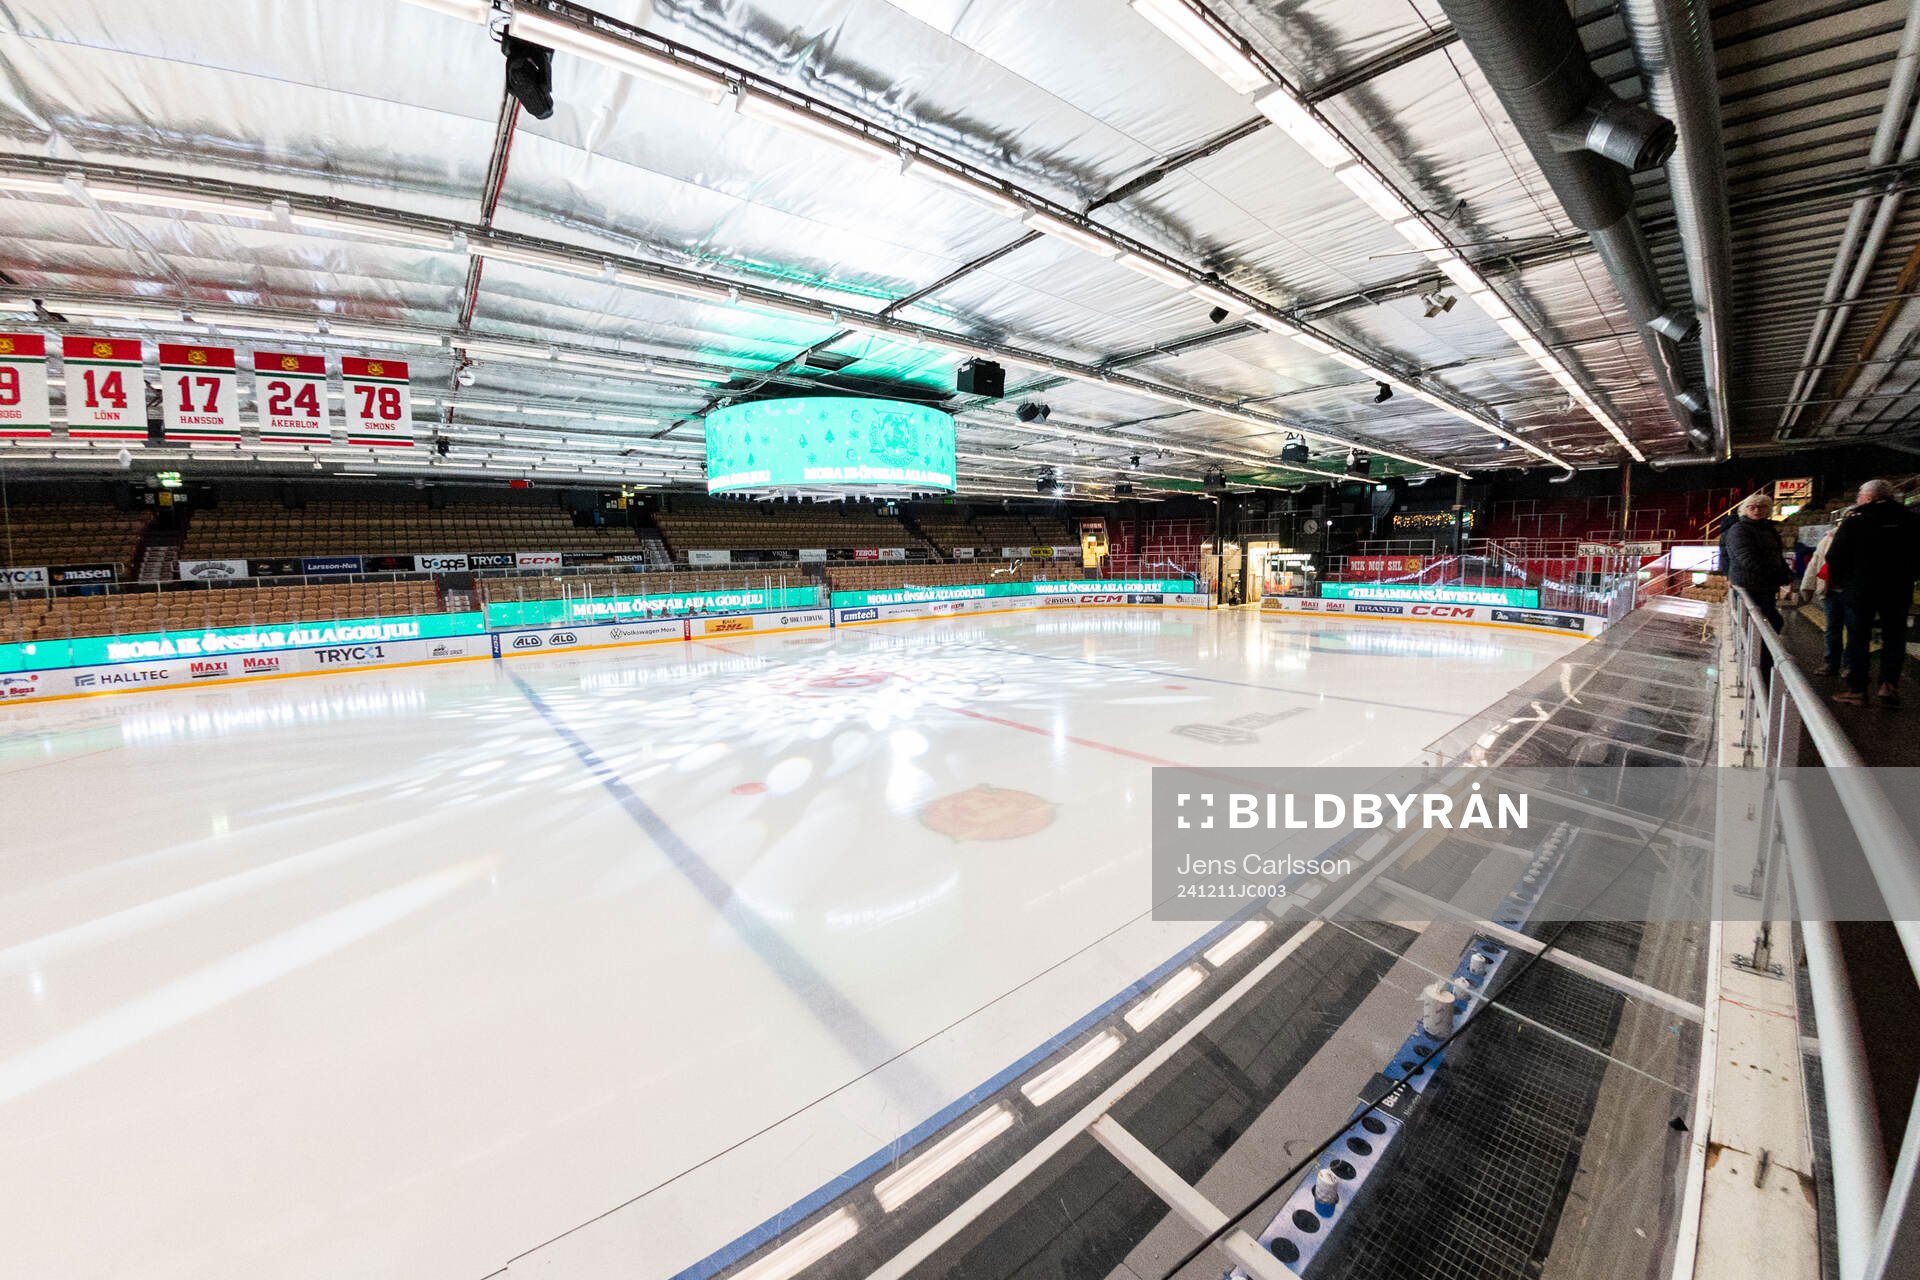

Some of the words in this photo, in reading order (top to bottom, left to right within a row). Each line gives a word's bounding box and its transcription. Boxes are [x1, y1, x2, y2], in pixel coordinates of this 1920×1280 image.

[83, 370, 127, 408] 14
[178, 376, 220, 413] 17
[267, 381, 321, 418] 24
[354, 385, 402, 421] 78
[180, 416, 224, 425] HANSSON
[364, 422, 396, 431] SIMONS
[518, 557, 560, 565] CCM
[614, 554, 643, 562] masen
[307, 562, 358, 570] Larsson-Hus
[1387, 560, 1403, 571] SHL
[64, 569, 111, 580] masen
[573, 600, 614, 615] MORA
[632, 597, 684, 611] ÖNSKAR
[716, 594, 741, 605] GOD
[1080, 595, 1123, 603] CCM
[843, 609, 876, 621] amtech
[1357, 605, 1400, 614] BRANDT
[1411, 605, 1475, 618] CCM
[623, 628, 659, 636] Volkswagen
[107, 640, 176, 659] MORA
[175, 638, 201, 654] IK
[201, 632, 286, 653] ÖNSKAR
[287, 629, 336, 645] ALLA
[337, 625, 380, 641] GOD
[190, 661, 228, 673] MAXI
[243, 657, 279, 668] MAXI
[101, 669, 169, 684] HALLTEC
